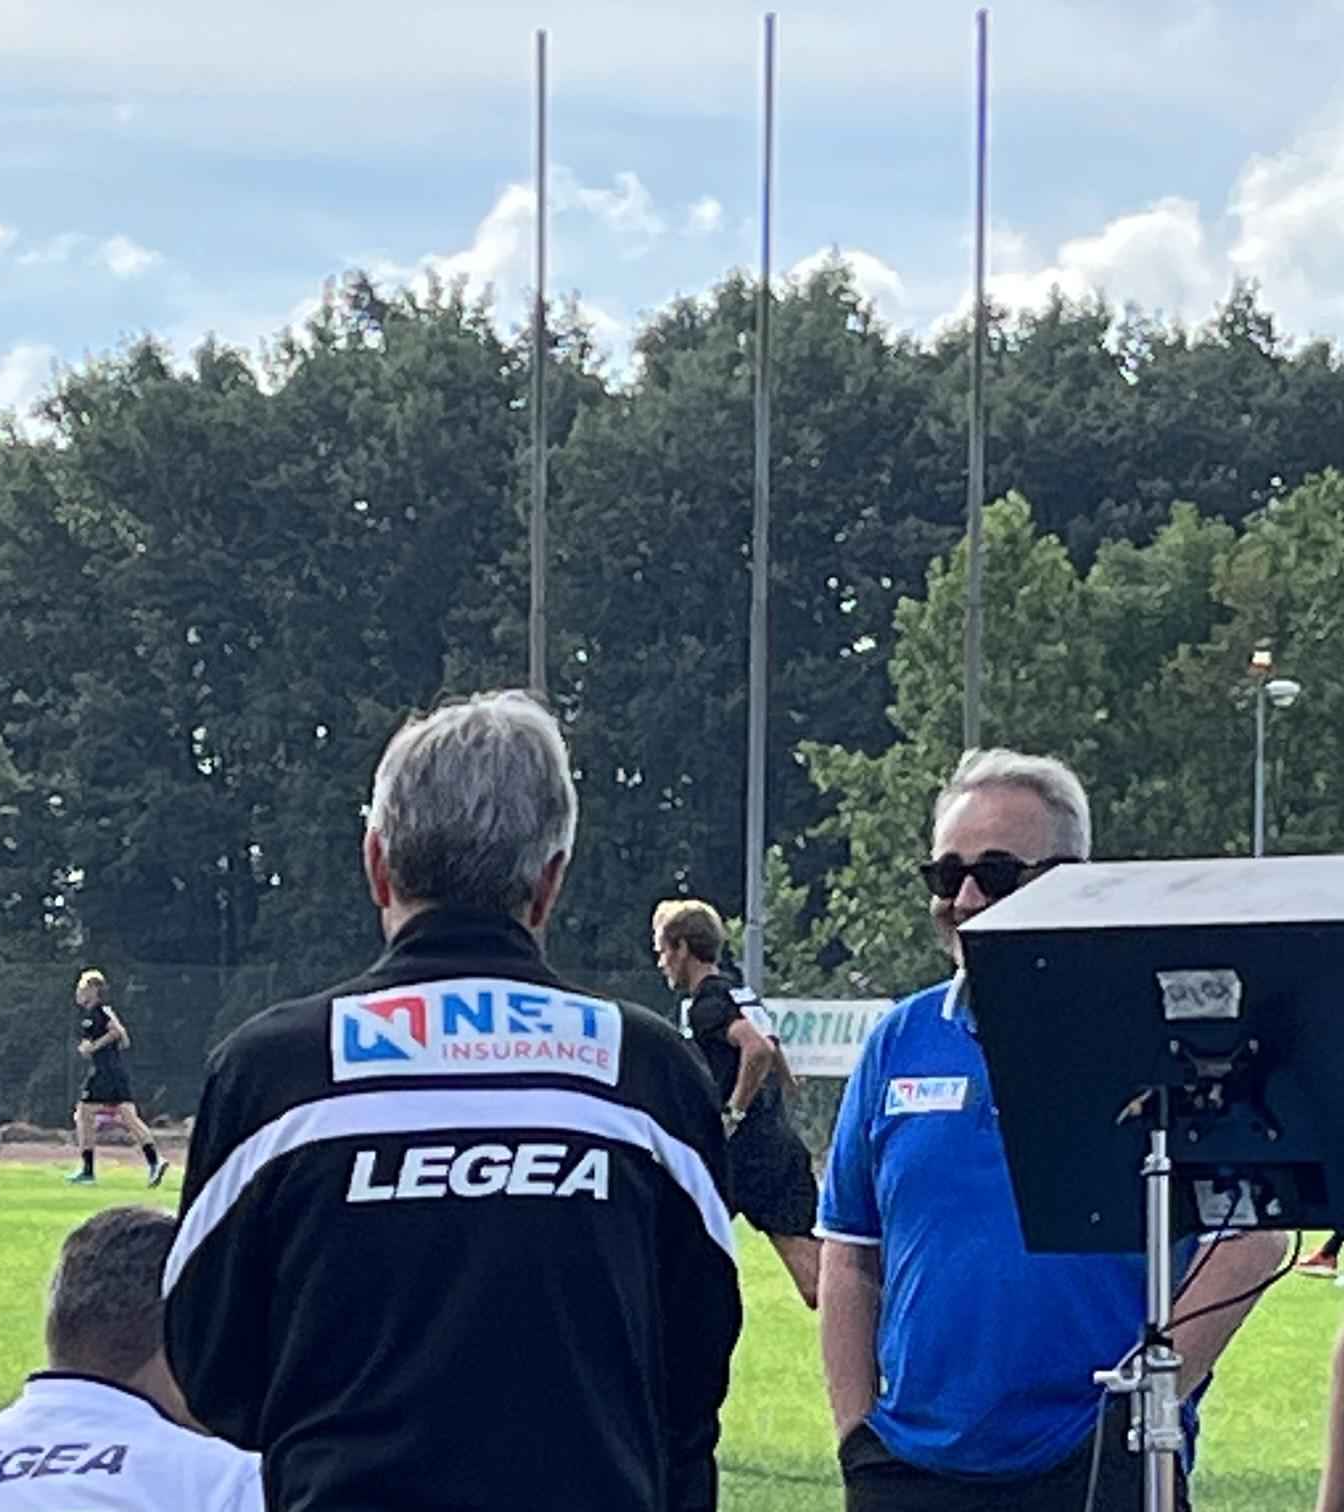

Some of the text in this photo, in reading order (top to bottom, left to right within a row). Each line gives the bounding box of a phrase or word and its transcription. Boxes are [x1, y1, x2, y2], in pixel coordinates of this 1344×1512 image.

[441, 990, 611, 1039] NET
[441, 1038, 611, 1070] INSURANCE
[346, 1143, 610, 1203] LEGEA
